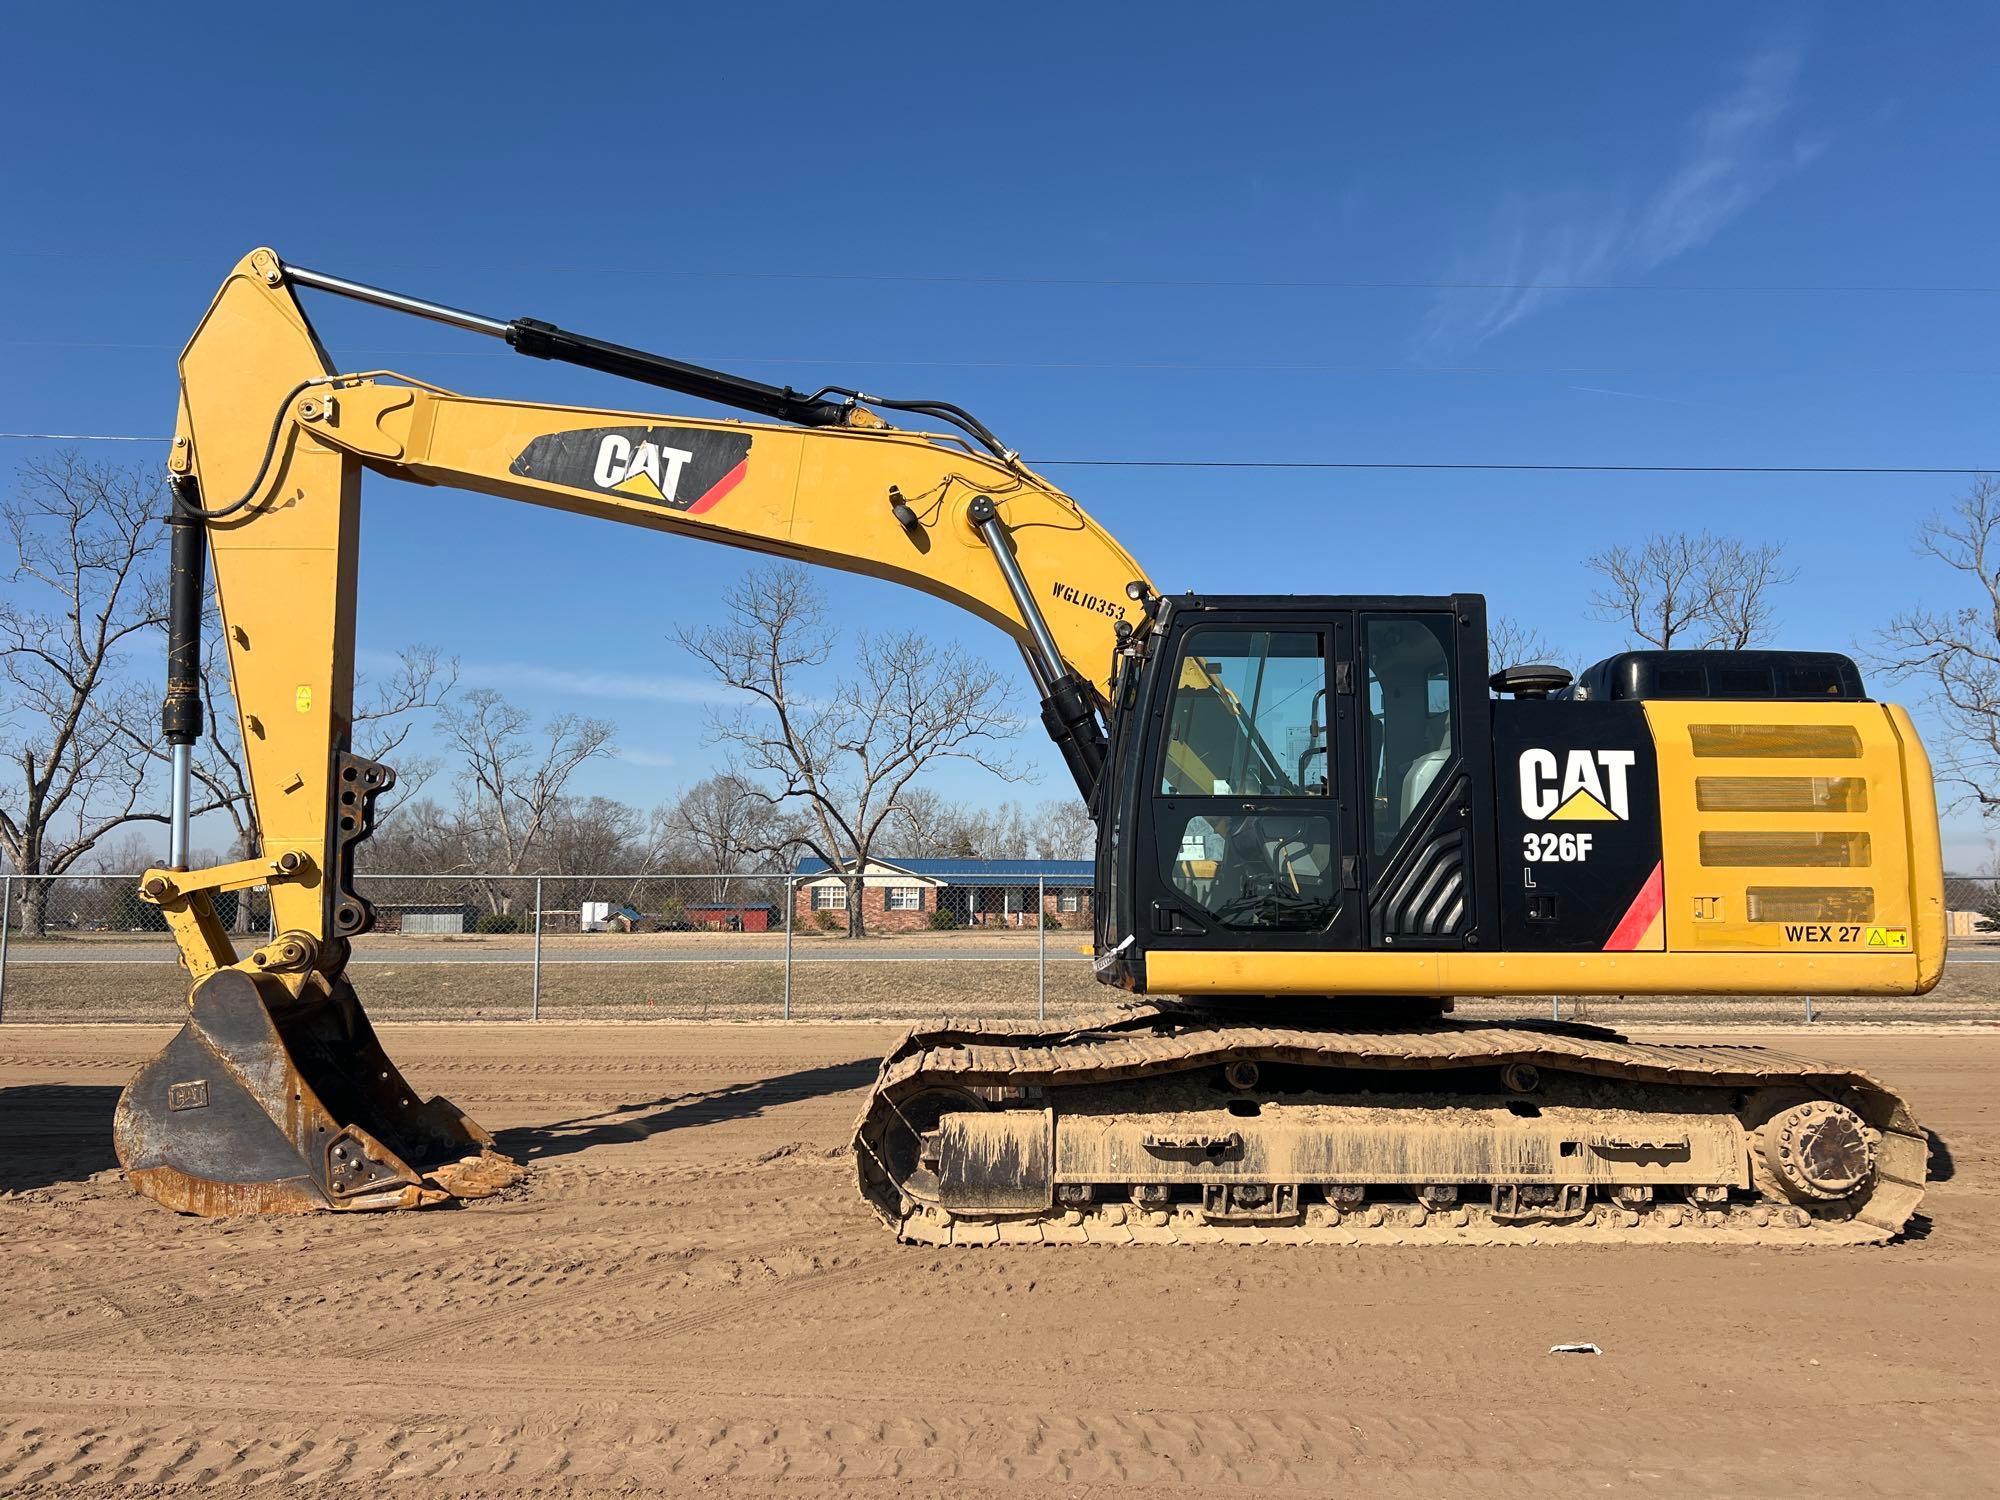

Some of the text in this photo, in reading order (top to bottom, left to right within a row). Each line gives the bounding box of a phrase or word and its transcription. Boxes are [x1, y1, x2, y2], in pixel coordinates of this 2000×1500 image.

[593, 434, 693, 502] CAT
[1519, 748, 1636, 821] CAT
[1523, 832, 1593, 862] 326F
[1524, 867, 1537, 888] L
[1785, 926, 1861, 942] WEX 27
